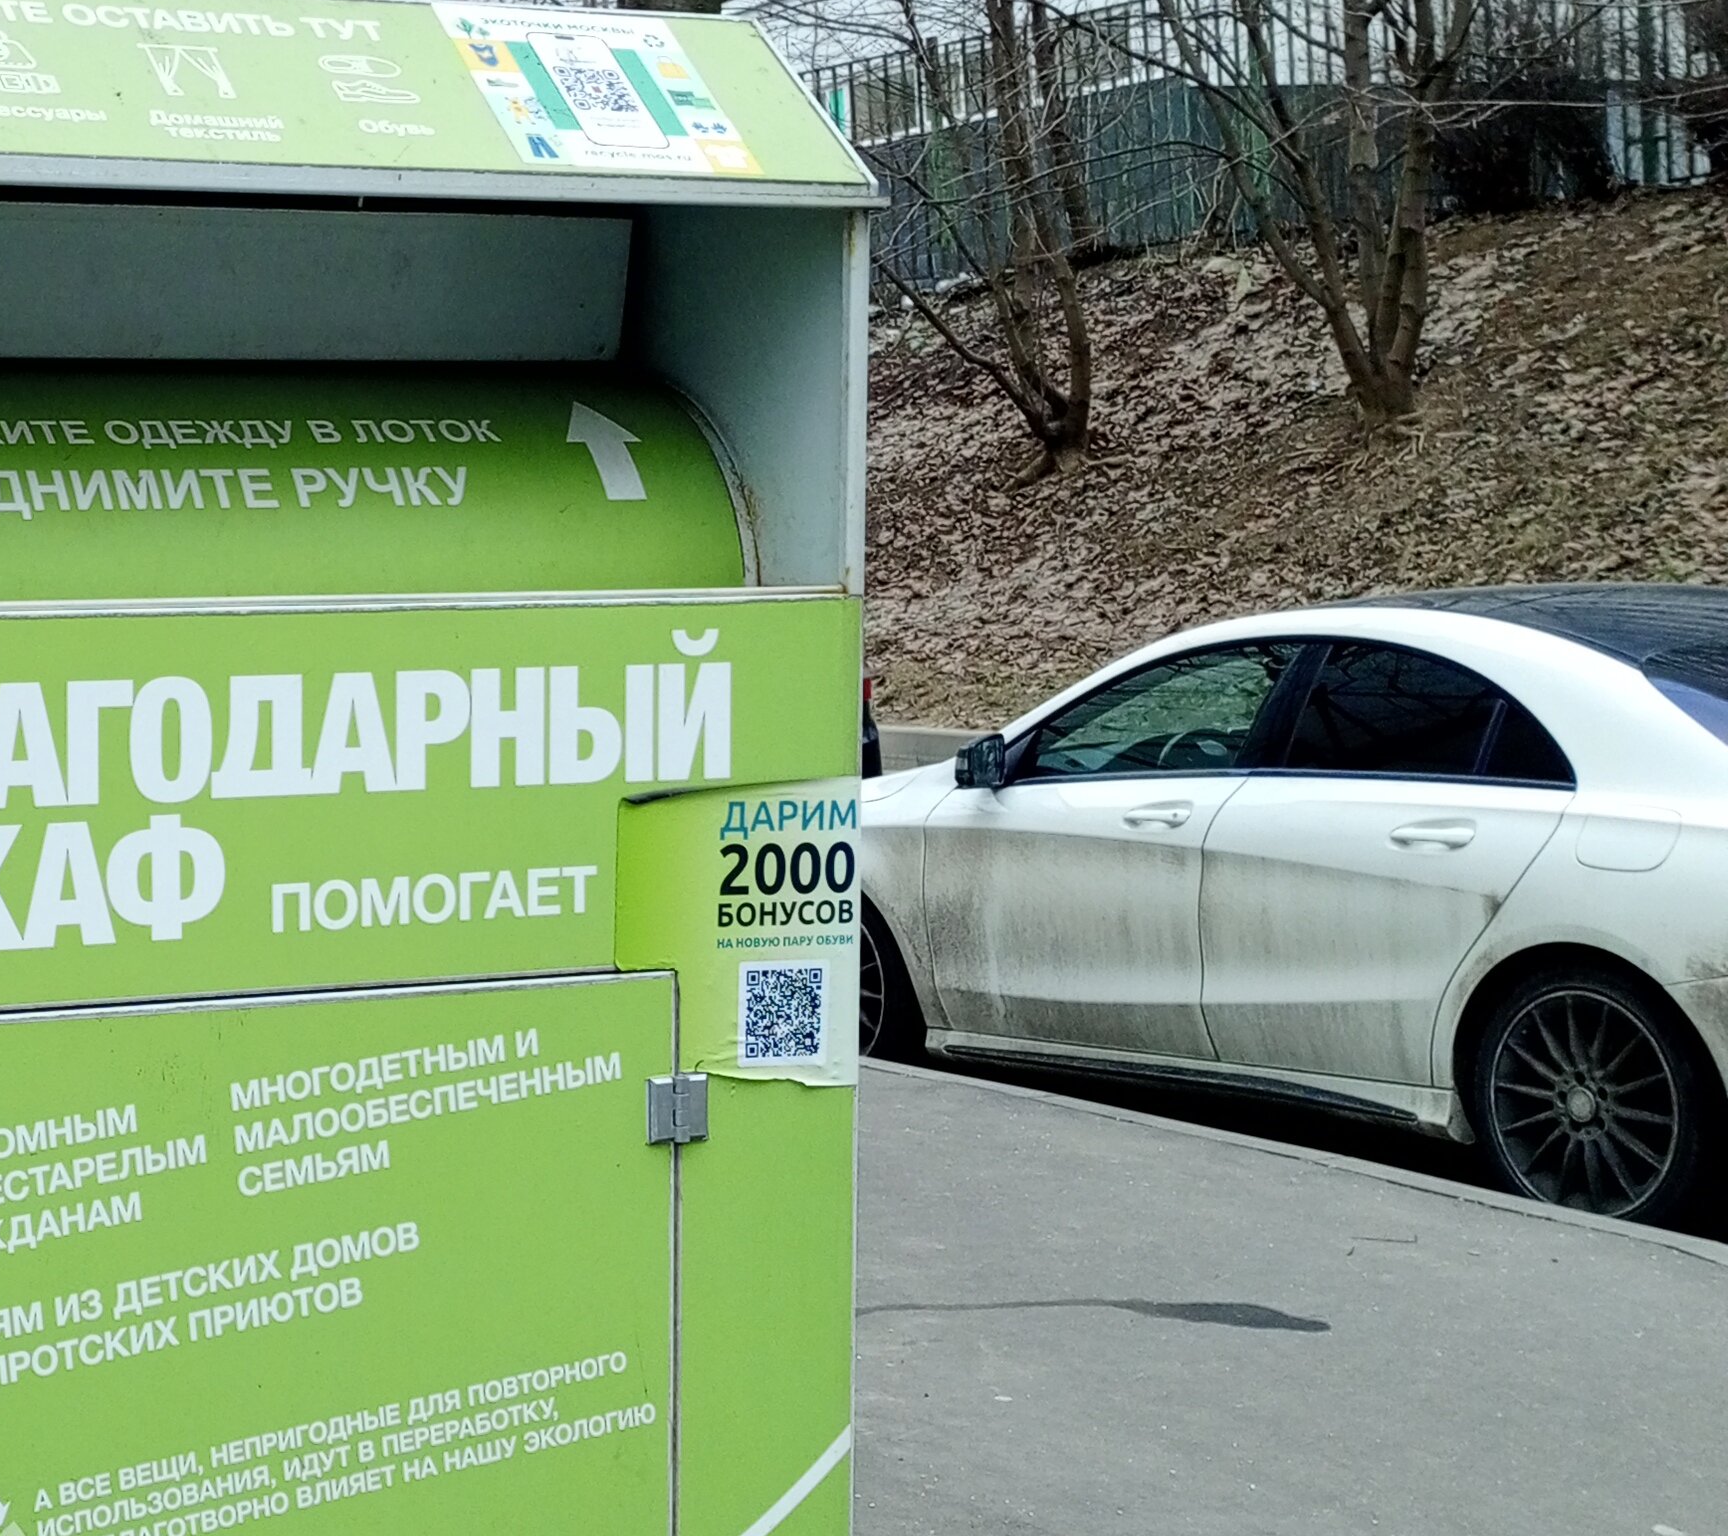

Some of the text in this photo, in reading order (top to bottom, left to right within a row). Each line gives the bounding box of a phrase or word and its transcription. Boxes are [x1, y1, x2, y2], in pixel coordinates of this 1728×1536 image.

[61, 3, 295, 37] ОСТАВИТЬ
[299, 16, 381, 42] ТУТ
[148, 109, 285, 130] Домашний
[164, 126, 282, 143] текстиль
[358, 118, 436, 137] Обувь
[104, 419, 292, 450] ОДЕЖДУ
[306, 420, 342, 444] В
[351, 419, 502, 444] ЛОТОК
[290, 466, 467, 509] РУЧКУ
[719, 799, 857, 841] ДАРИМ
[719, 841, 855, 896] 2000
[272, 865, 598, 935] ПОМОГАЕТ
[717, 899, 853, 927] БОНУСОВ
[717, 934, 854, 949] НА НОВУЮ ПАРУ ОБУВИ
[230, 1028, 539, 1112] МНОГОДЕТНЫМ И
[234, 1052, 622, 1155] МАЛООБЕСПЕЧЕННЫМ
[237, 1139, 390, 1196] СЕМЬЯМ
[54, 1290, 101, 1327] ИЗ
[113, 1249, 282, 1321] ДЕТСКИХ
[290, 1221, 420, 1280] ДОМОВ
[188, 1276, 363, 1344] ПРИЮТОВ
[33, 1351, 627, 1513] А ВСЕ ВЕЩИ, НЕПРИГОДНЫЕ ДЛЯ ПОВТОРНОГО
[283, 1445, 351, 1481] ИДУТ
[358, 1440, 375, 1463] В
[381, 1397, 559, 1458] ПЕРЕРАБОТКУ,
[296, 1465, 396, 1509] ВЛИЯЕТ
[402, 1456, 438, 1483] НА
[443, 1435, 517, 1472] НАШУ
[523, 1402, 656, 1454] ЭКОЛОГИЮ
